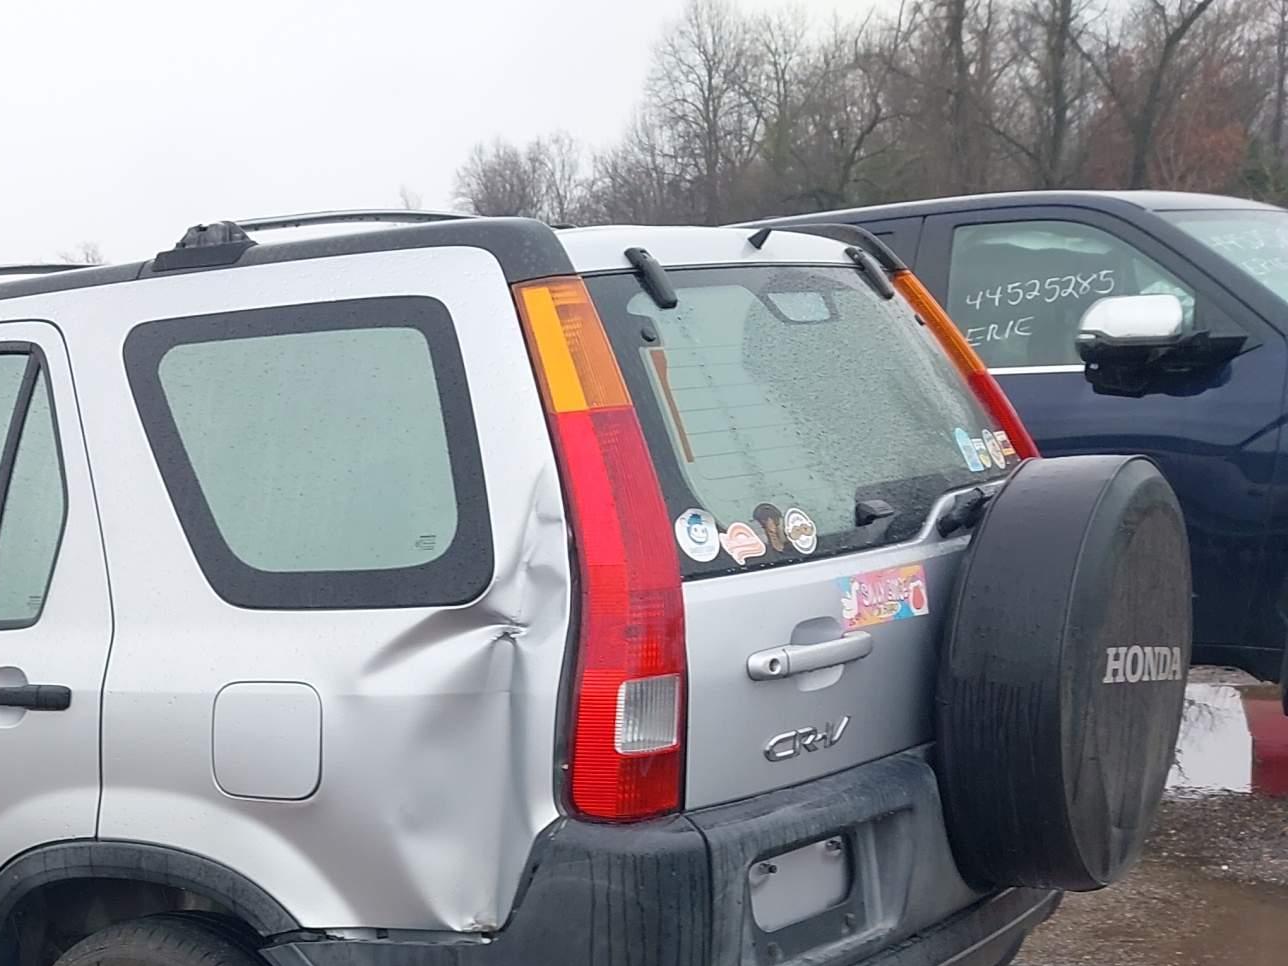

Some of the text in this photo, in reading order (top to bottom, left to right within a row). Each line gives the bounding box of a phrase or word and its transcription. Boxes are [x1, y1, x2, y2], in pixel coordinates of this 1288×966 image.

[965, 270, 1115, 311] 44525285
[965, 315, 1036, 347] ERIE
[1102, 645, 1183, 684] HONDA
[763, 715, 851, 762] CR-V
